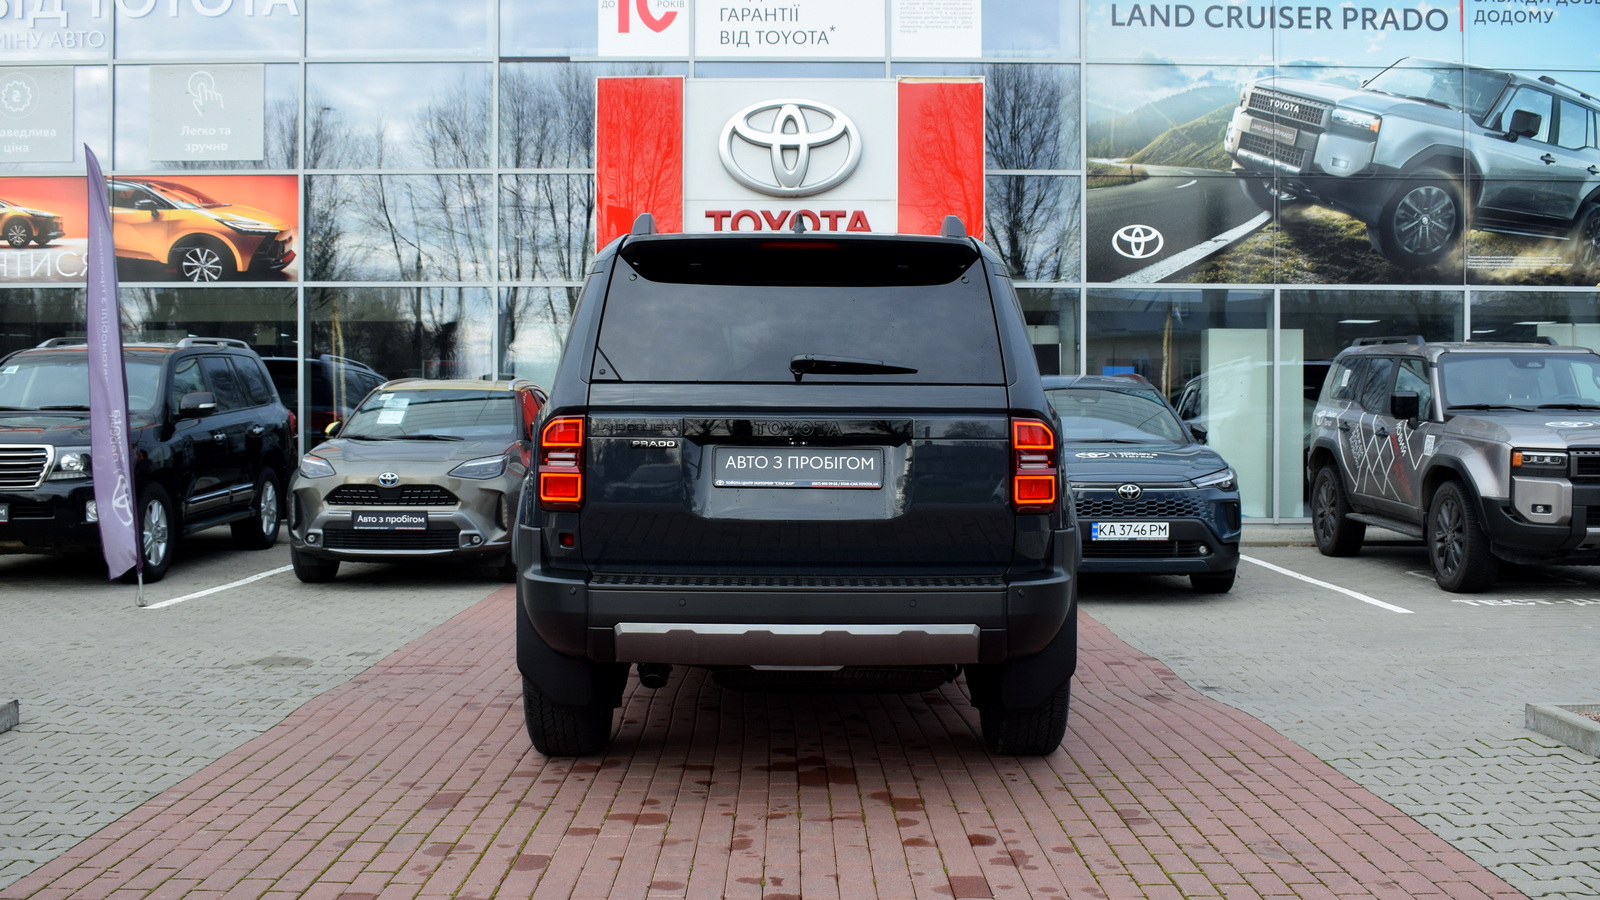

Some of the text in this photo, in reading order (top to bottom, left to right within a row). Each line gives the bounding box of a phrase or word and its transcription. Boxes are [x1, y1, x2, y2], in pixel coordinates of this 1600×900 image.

[719, 4, 801, 22] ГАРАНТІЇ
[1111, 3, 1450, 32] LAND CRUISER PRADO
[1473, 9, 1554, 26] ДОДОМУ
[49, 30, 106, 49] АВТО
[719, 30, 750, 48] ВІД
[1269, 99, 1300, 114] TOYOTA
[180, 125, 232, 136] Легко та
[3, 142, 29, 154] ціна
[184, 143, 229, 154] зручно
[705, 209, 872, 232] TOYOTA
[754, 420, 844, 437] TOYOTA
[632, 440, 676, 448] PRADO
[725, 455, 874, 471] АВТО З ПРОБІГОМ
[357, 515, 377, 523] Авто
[385, 515, 425, 524] пробігом
[1099, 524, 1167, 536] KA 3746 PM
